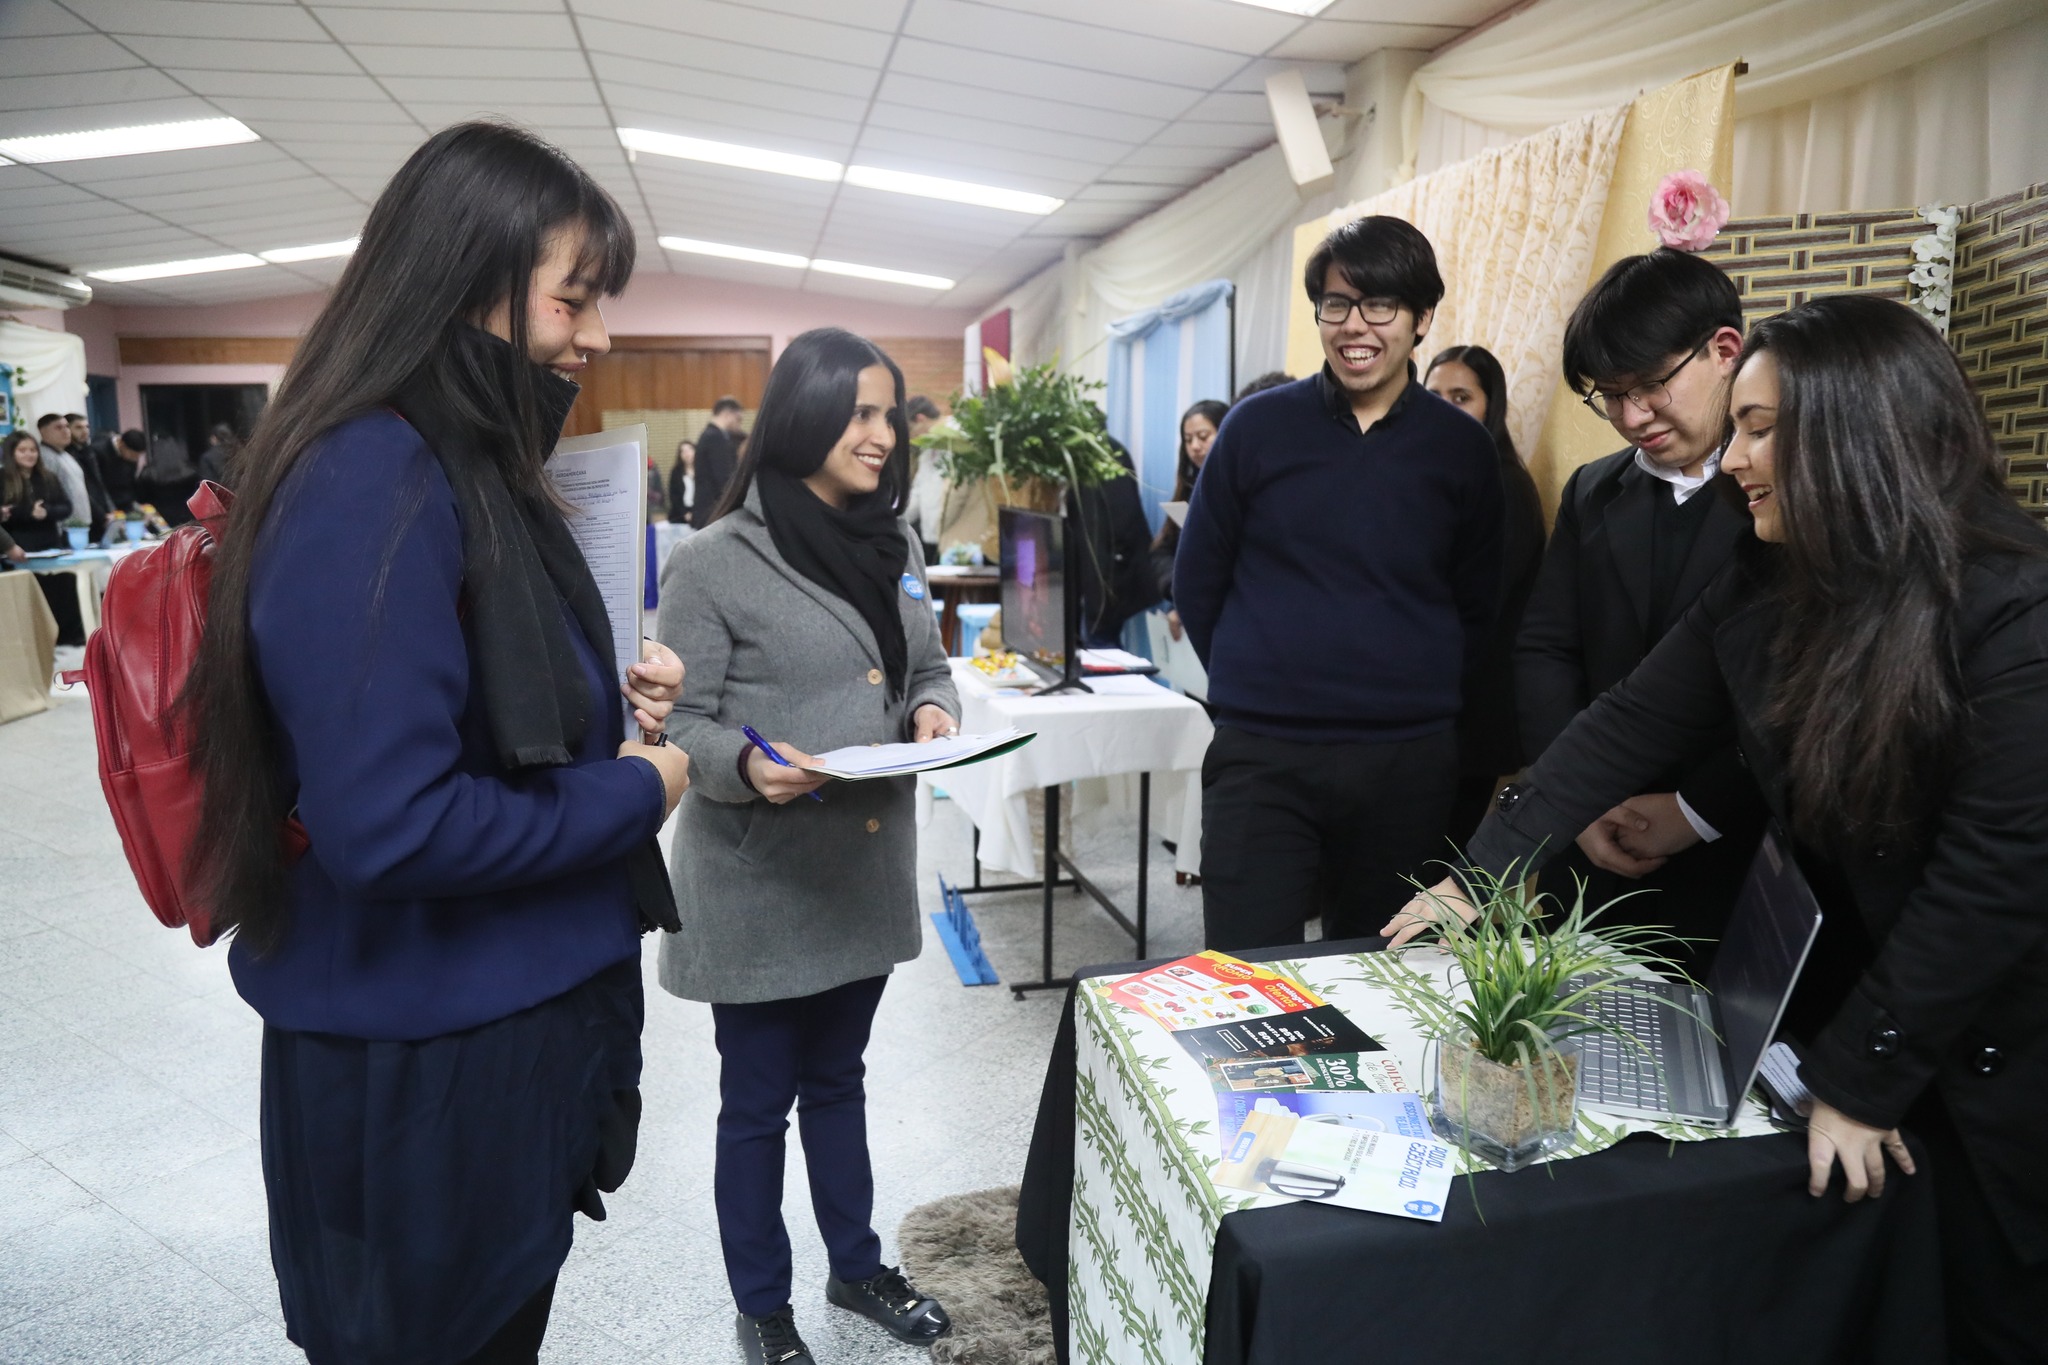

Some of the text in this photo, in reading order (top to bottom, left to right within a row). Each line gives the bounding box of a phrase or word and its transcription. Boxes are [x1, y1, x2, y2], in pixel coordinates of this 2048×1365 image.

[1212, 964, 1252, 980] PROMO
[1224, 963, 1254, 976] SUPER
[1264, 984, 1297, 1008] Ofertas
[1276, 982, 1304, 1004] Catálogo
[1244, 1029, 1266, 1048] REBAJAS
[1262, 1021, 1280, 1039] HASTA
[1319, 1064, 1335, 1088] DESCUENTO
[1326, 1058, 1356, 1087] 30%
[1365, 1062, 1382, 1072] de
